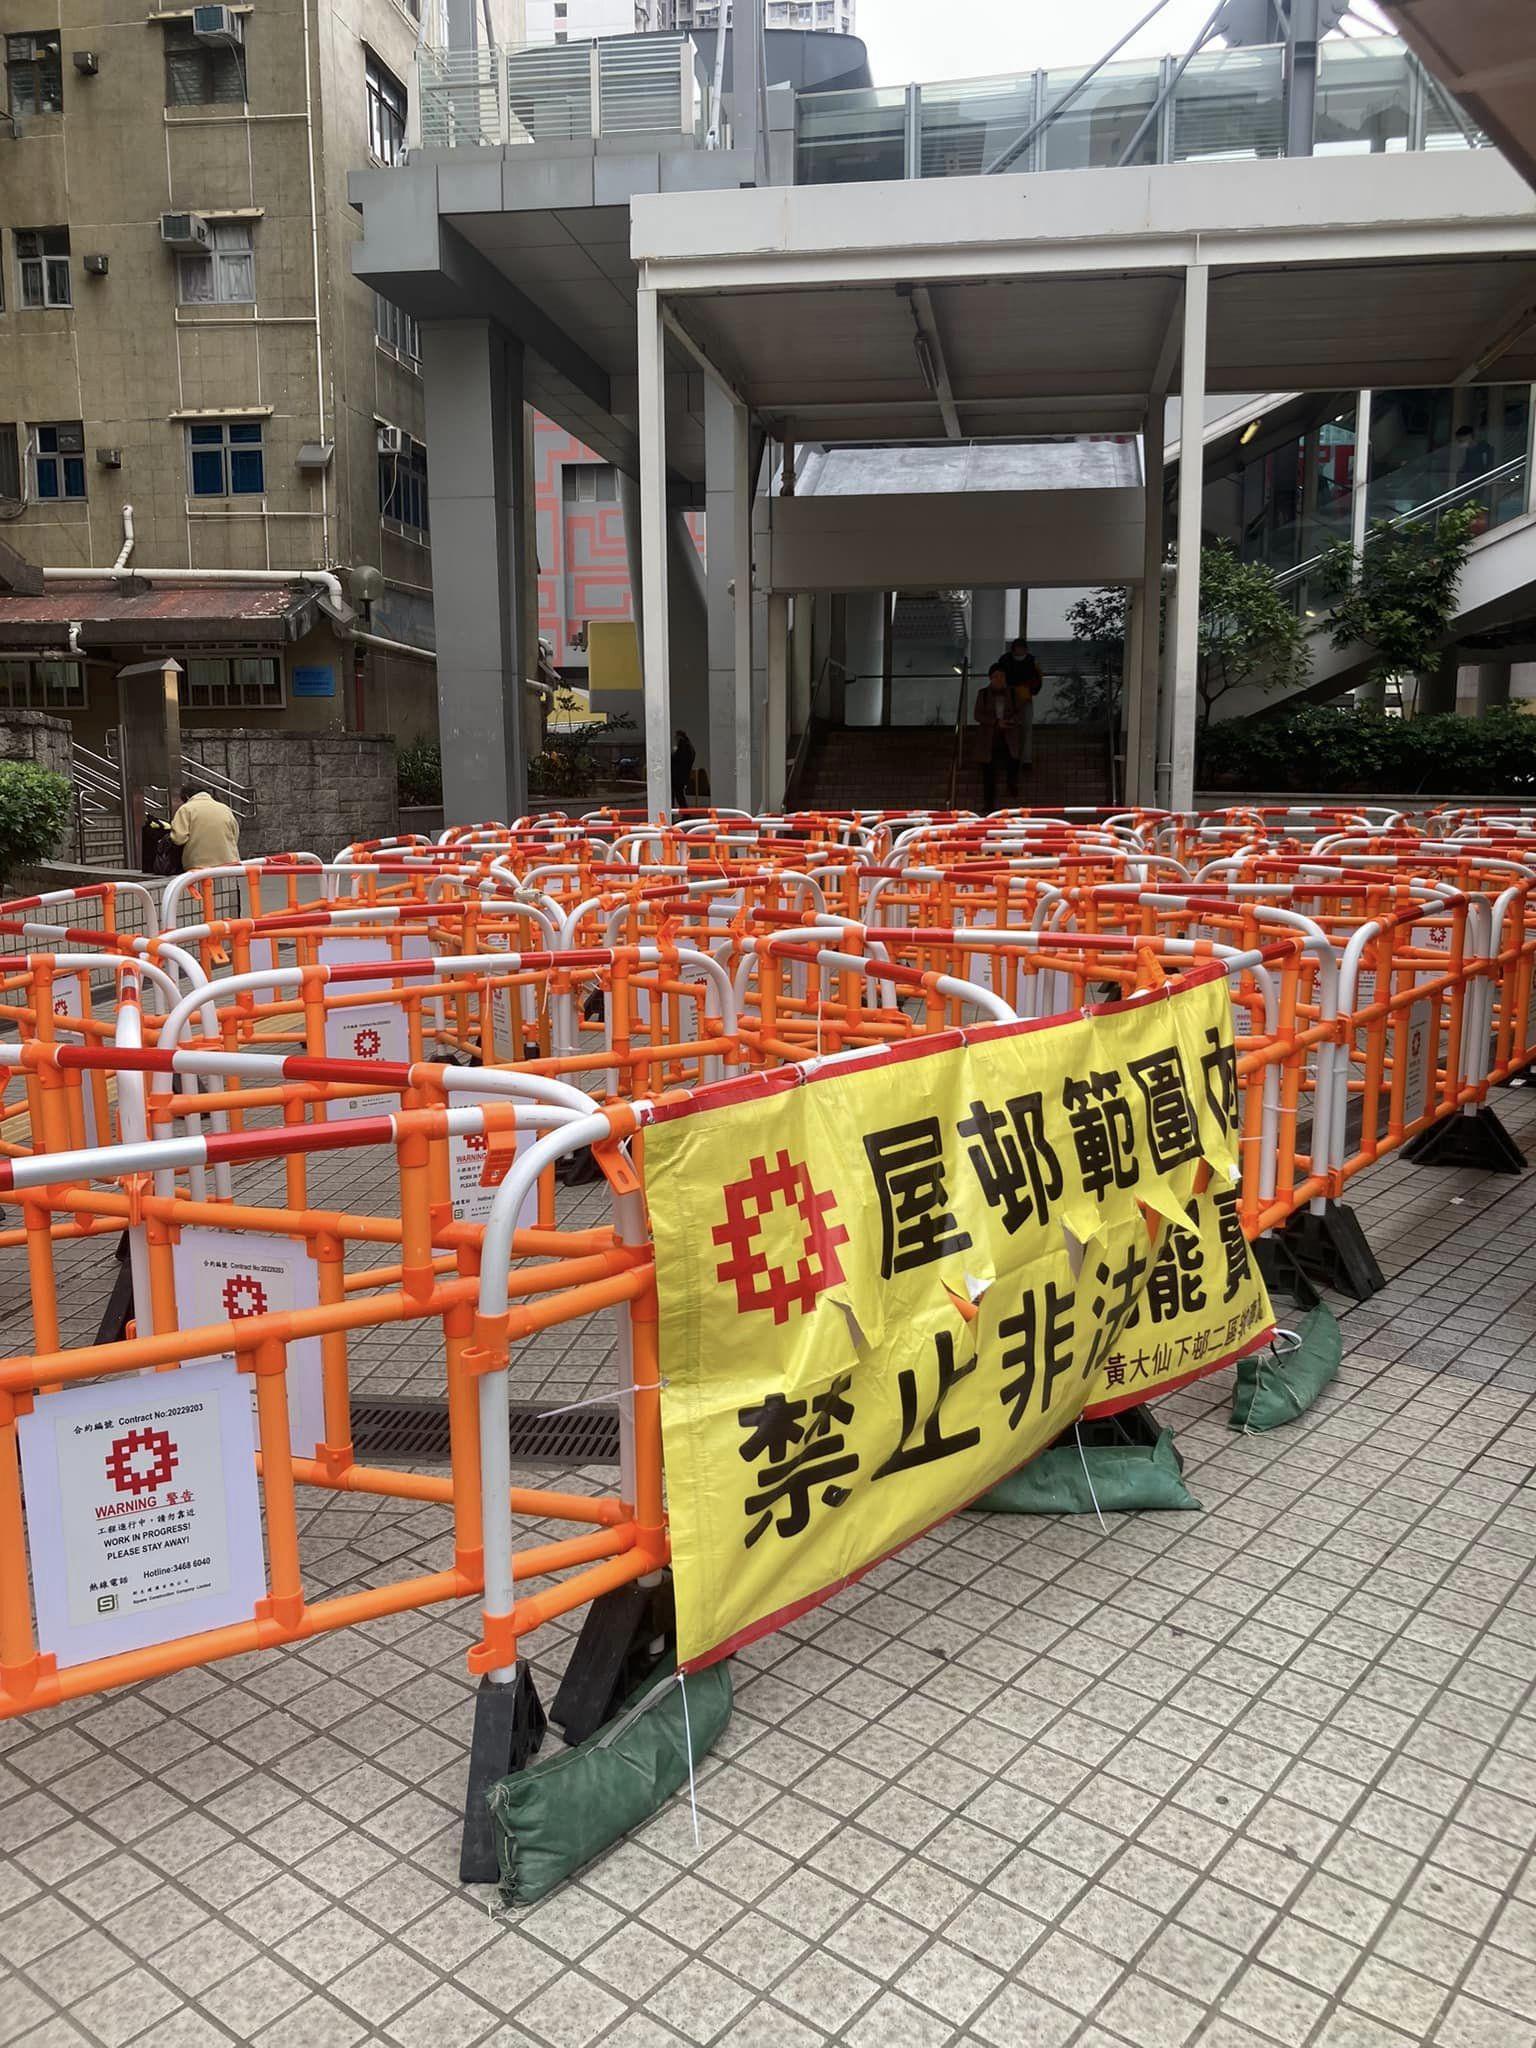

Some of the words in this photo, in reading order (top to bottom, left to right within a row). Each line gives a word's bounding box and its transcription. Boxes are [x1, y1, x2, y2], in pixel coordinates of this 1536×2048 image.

[118, 1413, 153, 1426] Contract
[154, 1403, 204, 1419] No:20229203
[95, 1496, 157, 1518] WARNING
[166, 1489, 194, 1505] 警告
[103, 1535, 130, 1548] WORK
[132, 1533, 141, 1542] IN
[142, 1522, 191, 1540] PROGRESS!
[107, 1546, 140, 1560] PLEASE
[142, 1541, 163, 1553] STAY
[164, 1535, 190, 1548] AWAY!
[193, 1557, 211, 1568] 6040
